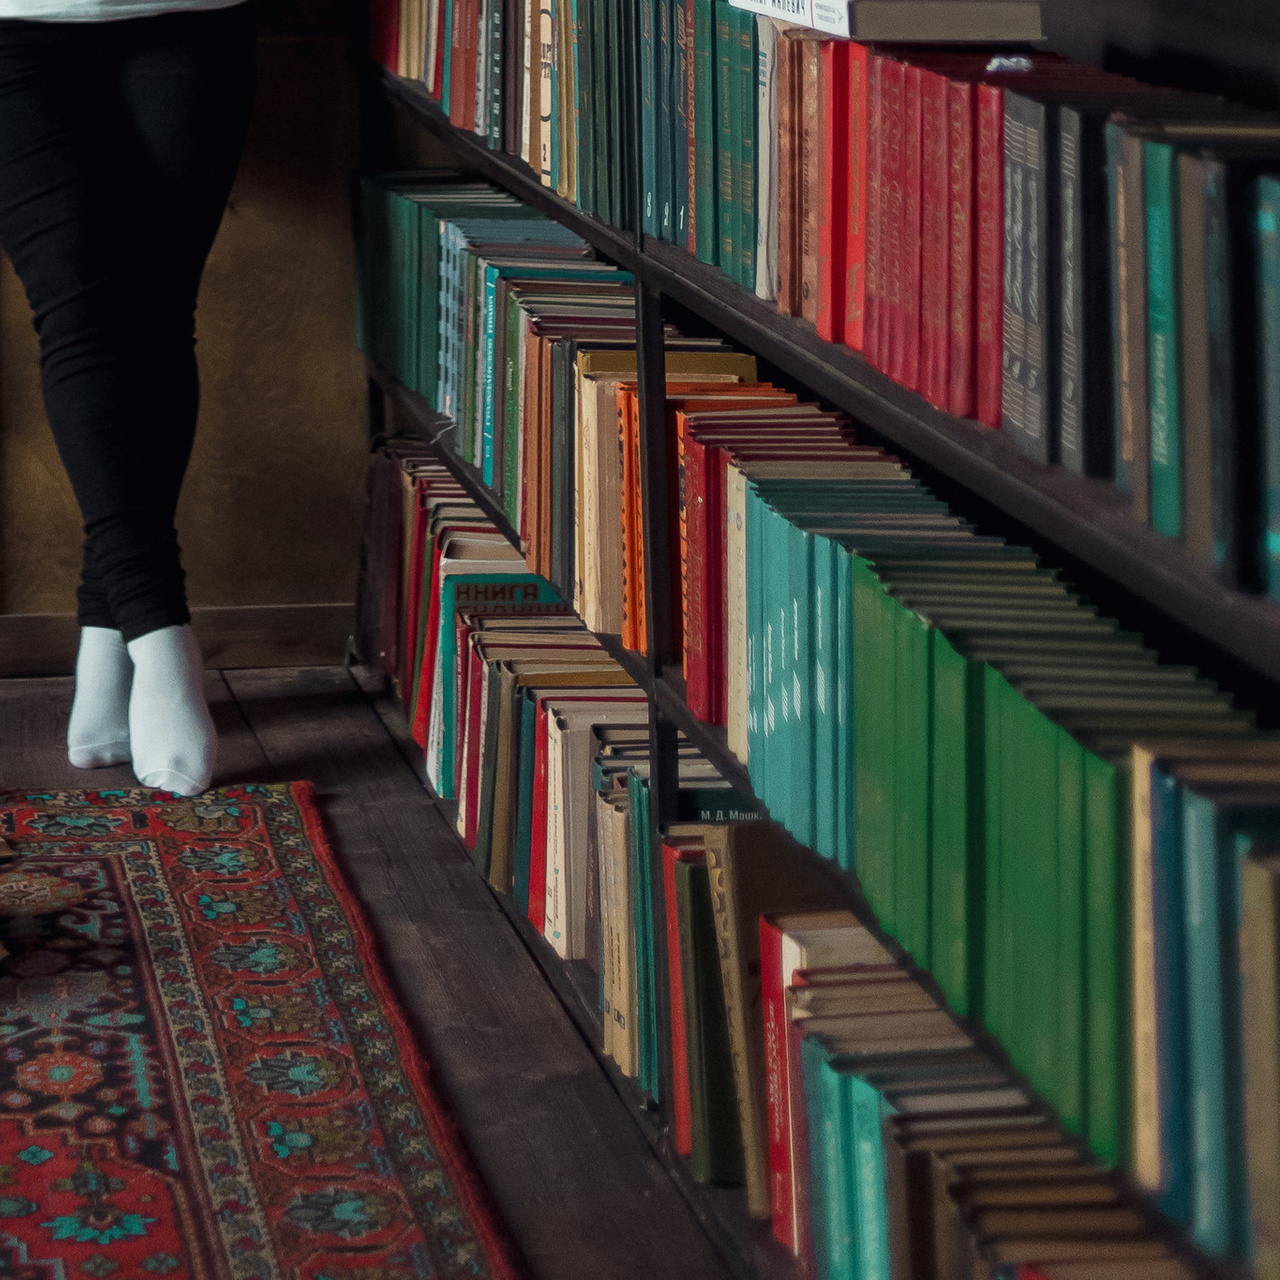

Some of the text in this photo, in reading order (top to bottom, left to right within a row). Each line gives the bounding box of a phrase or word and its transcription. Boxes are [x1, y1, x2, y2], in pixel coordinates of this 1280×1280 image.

[686, 33, 696, 237] МИХАИЛ ШОЛОХОВ
[645, 191, 653, 218] 3
[663, 201, 670, 226] 2
[679, 205, 685, 230] 1
[701, 810, 714, 821] М.
[715, 809, 727, 822] Д.
